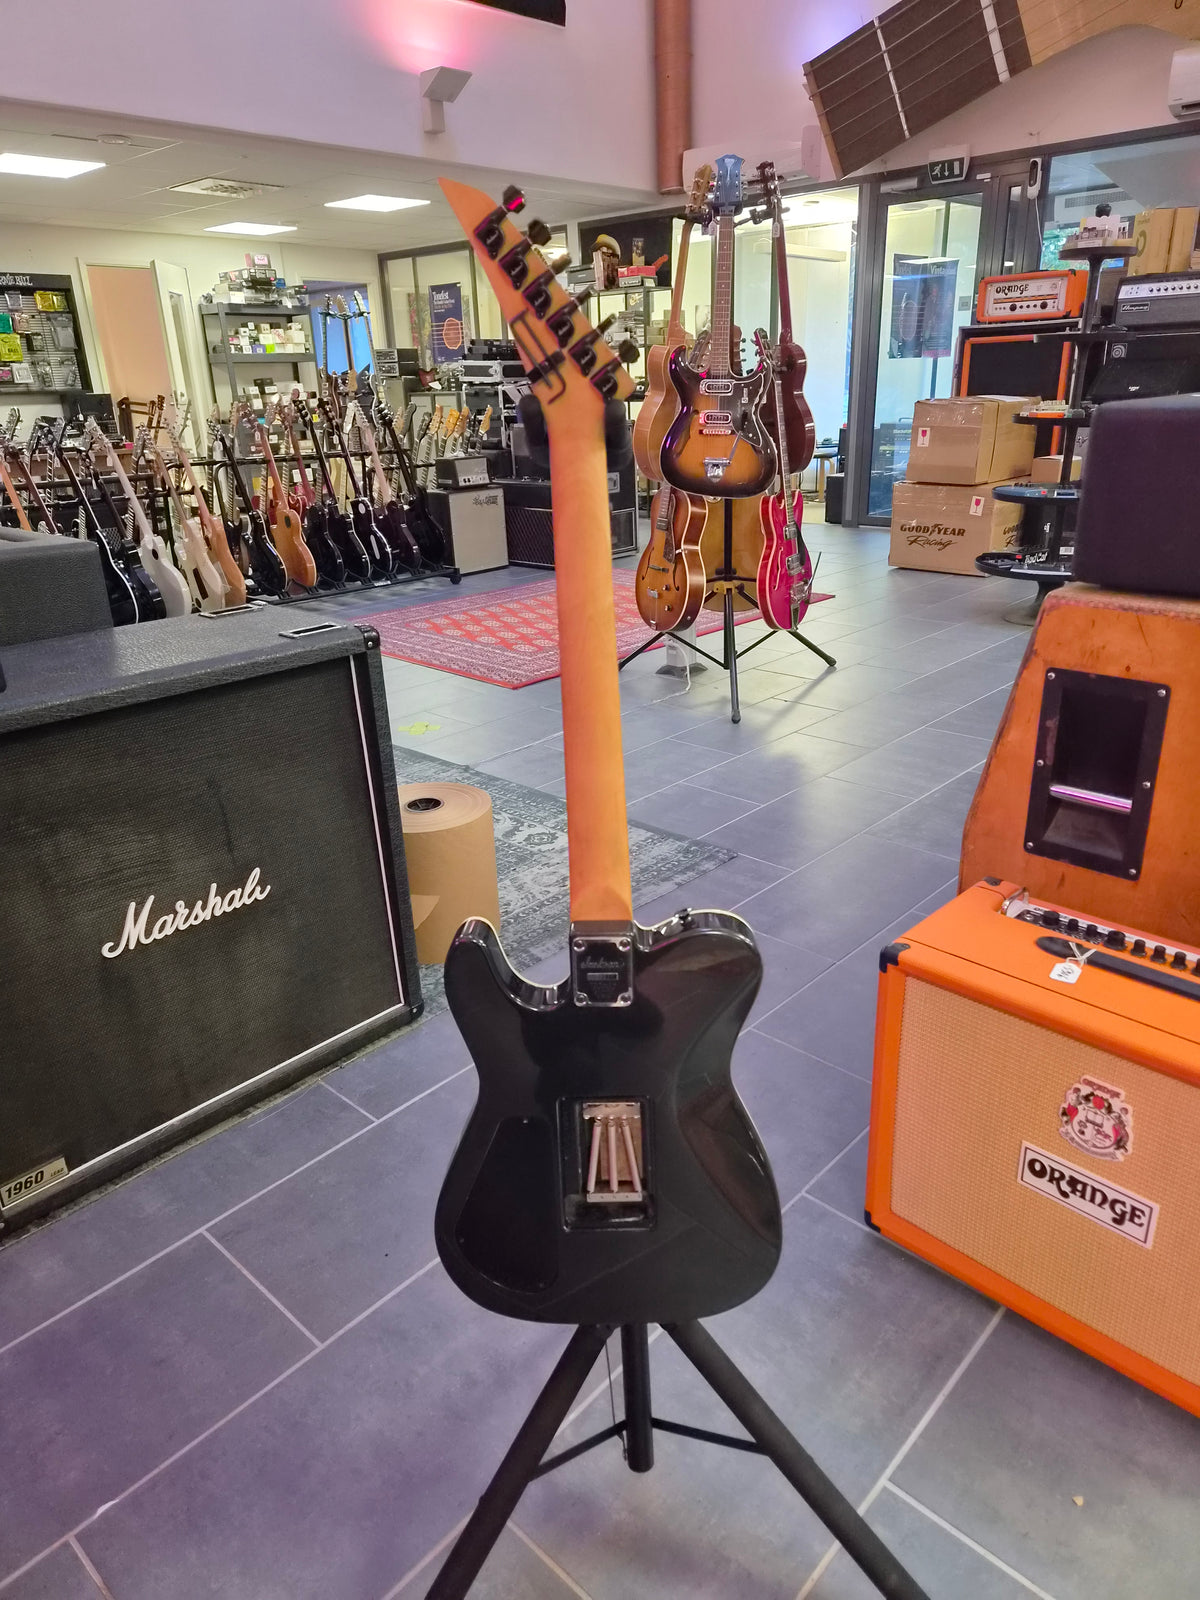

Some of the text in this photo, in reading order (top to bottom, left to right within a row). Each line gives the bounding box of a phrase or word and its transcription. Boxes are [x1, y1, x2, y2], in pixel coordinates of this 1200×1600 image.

[995, 283, 1029, 296] ORANGE
[906, 535, 958, 551] Racing
[5, 1170, 44, 1199] 1960
[1027, 1157, 1147, 1228] ORANGE
